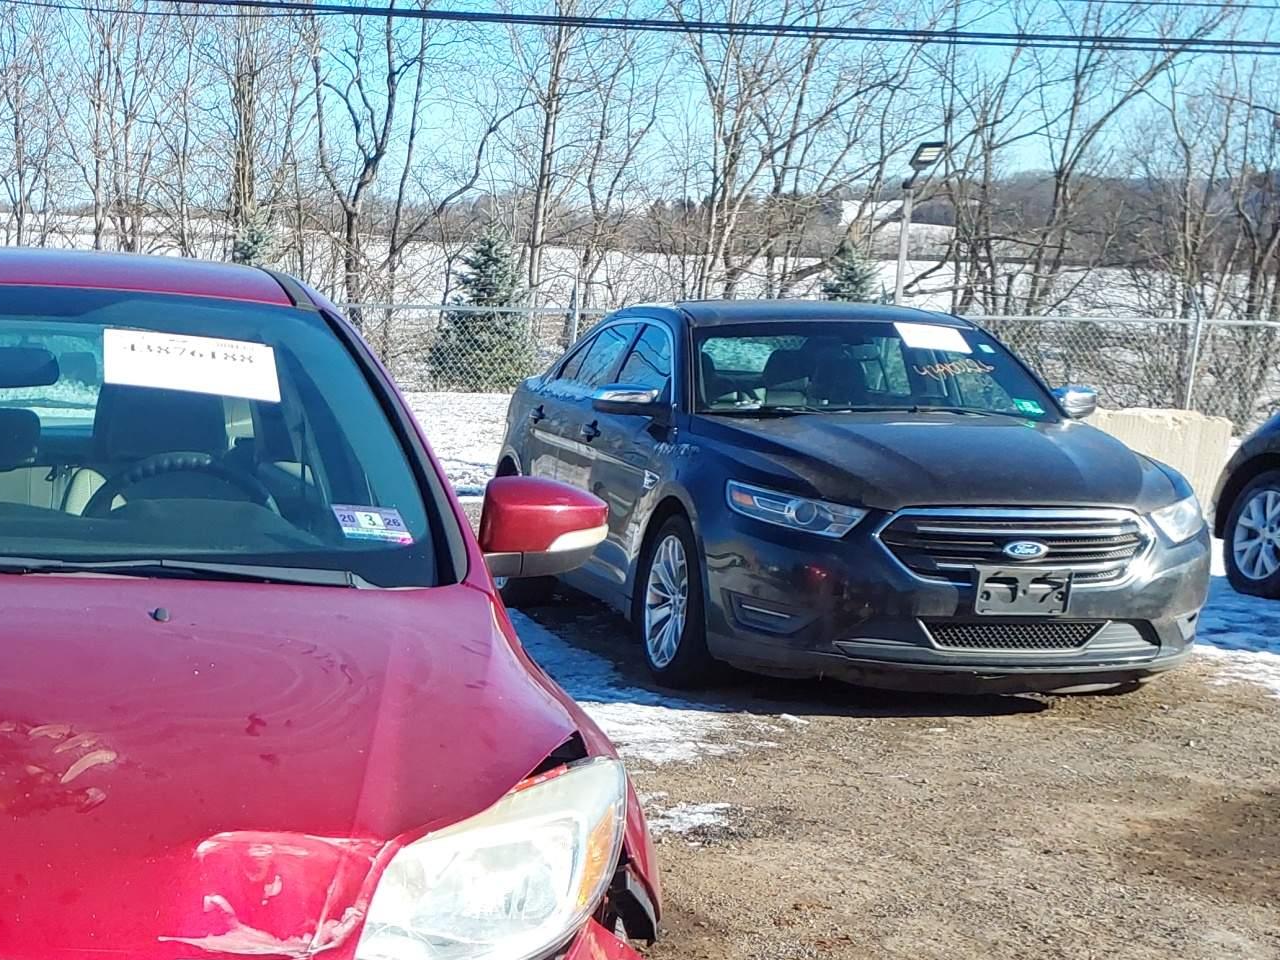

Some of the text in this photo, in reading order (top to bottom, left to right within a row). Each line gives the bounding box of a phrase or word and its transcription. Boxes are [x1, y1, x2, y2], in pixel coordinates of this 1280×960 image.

[339, 513, 401, 527] 20 3 26
